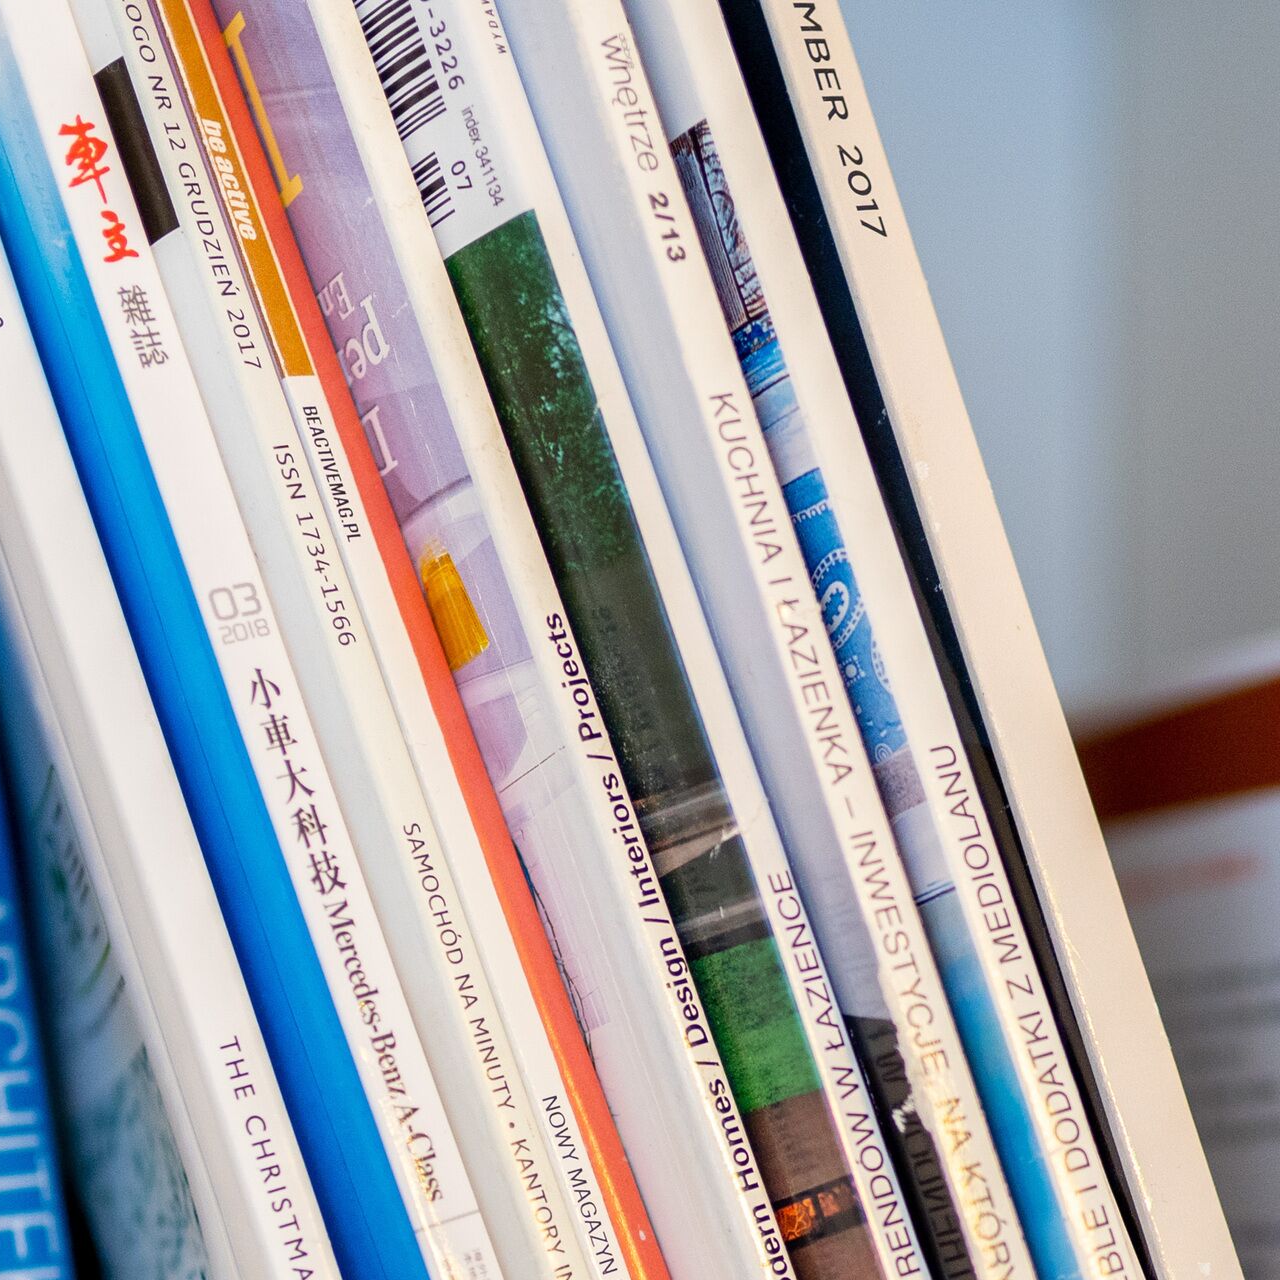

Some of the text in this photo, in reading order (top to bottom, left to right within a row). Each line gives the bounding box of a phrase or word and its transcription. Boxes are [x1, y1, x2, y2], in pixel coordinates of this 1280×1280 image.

[120, 0, 262, 369] OGO NR 12 GRUDZIEŃ 2017
[201, 118, 258, 243] be active
[451, 160, 474, 191] 07
[461, 104, 505, 208] index 341134
[793, 2, 888, 237] MBER 2017
[302, 406, 361, 542] BEACTIVEMAG.PL
[709, 392, 783, 564] KUCHNIA
[208, 581, 263, 626] 03
[273, 444, 357, 646] ISSN 1734-1566
[768, 576, 793, 585] I
[220, 617, 271, 647] 2018
[546, 607, 601, 742] Projects
[779, 598, 853, 785] ŁAZIENKA
[602, 773, 658, 908] Interiors
[929, 745, 1023, 964] MEDIOLANU
[250, 667, 443, 1202] 小車大科技 Mercedes-Benz A-Class
[403, 823, 464, 965] SAMOCHÓD
[454, 973, 478, 1010] NA
[469, 1017, 516, 1109] MINUTY
[659, 937, 709, 1048] Design
[767, 867, 845, 1052] ŁAZIENCE
[849, 830, 951, 1076] INWESTYCJE
[1005, 974, 1034, 999] Z
[219, 1035, 256, 1100] THE
[831, 1064, 861, 1102] W
[943, 1097, 973, 1153] NA
[1017, 1010, 1091, 1173] DODATKI
[542, 1095, 579, 1160] NOWY
[567, 1167, 618, 1275] MAGAZYN
[710, 1079, 759, 1193] Homes
[1077, 1184, 1098, 1194] I
